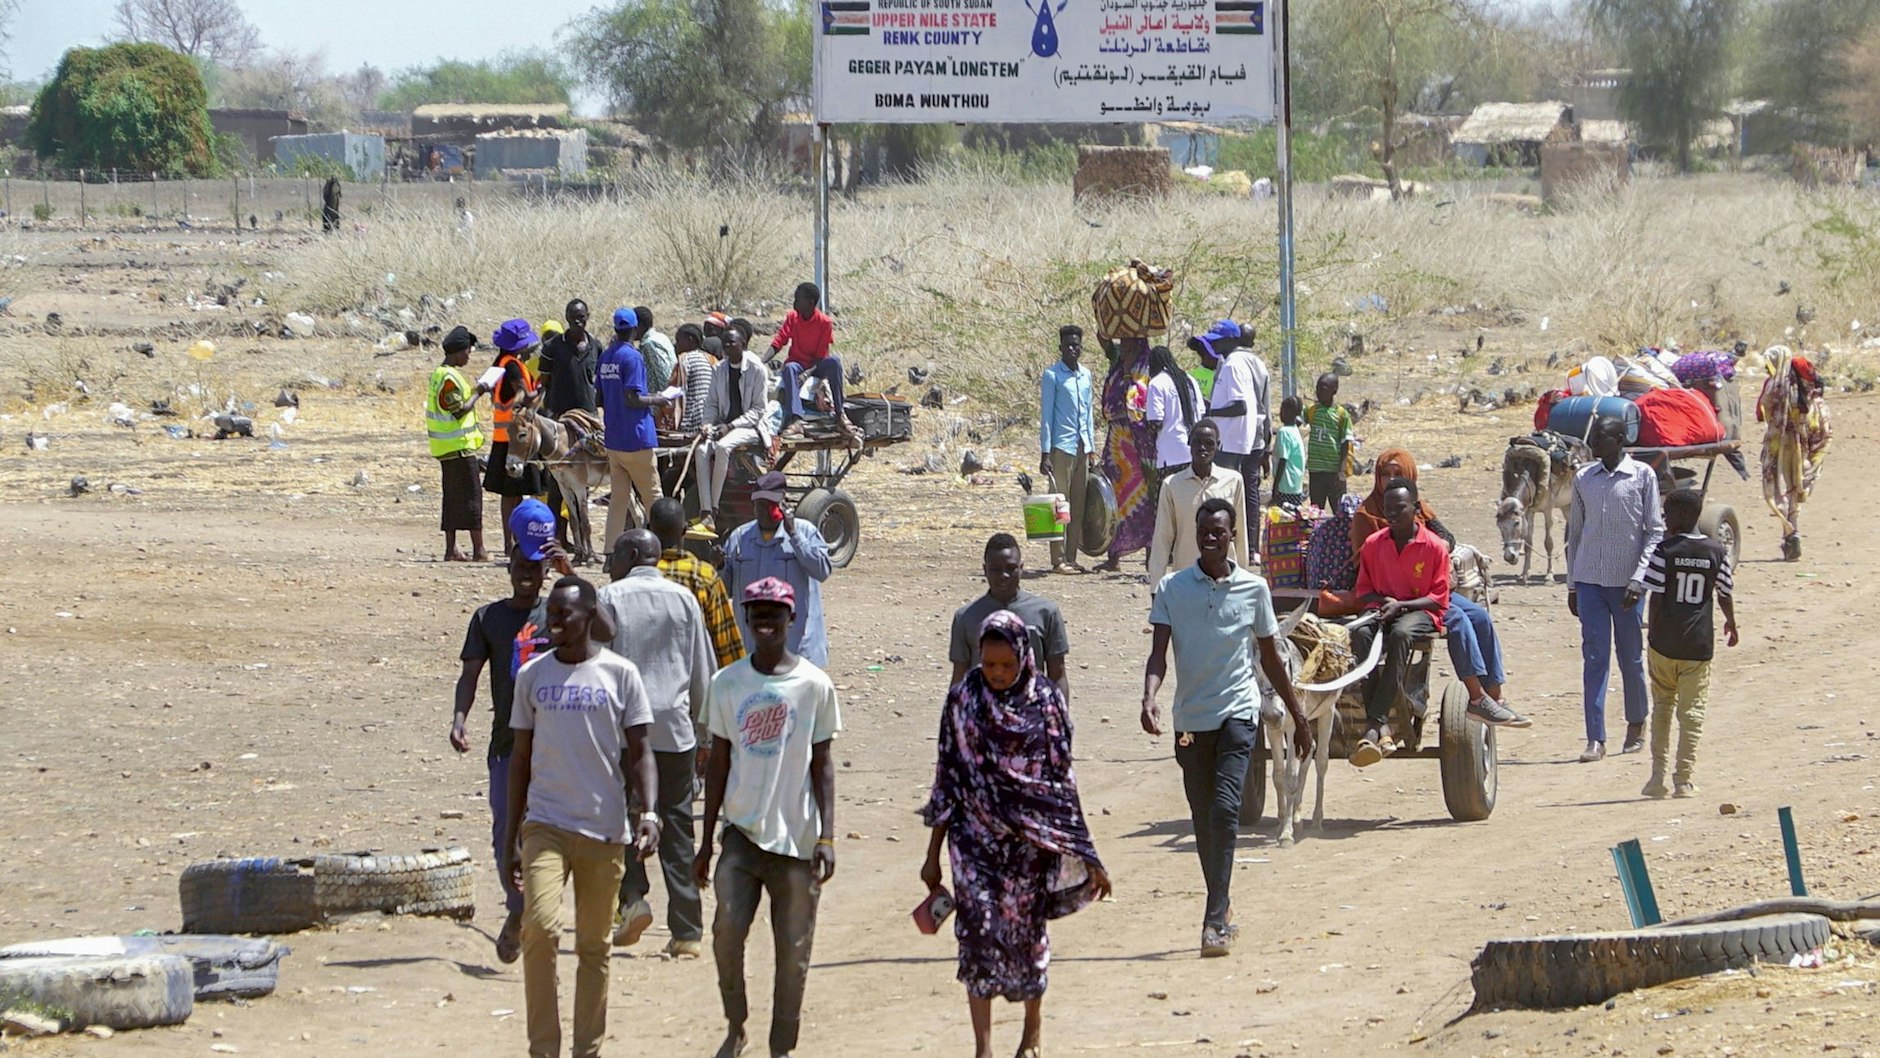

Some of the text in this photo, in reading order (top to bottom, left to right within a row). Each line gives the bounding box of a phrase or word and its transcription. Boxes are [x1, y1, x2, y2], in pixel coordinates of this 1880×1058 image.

[878, 0, 993, 9] REPUBLIC OF SOUTH SUDAN
[872, 13, 997, 27] UPPER NILE STATE
[1099, 14, 1132, 35] النيل
[1171, 14, 1210, 34] ولاية
[883, 30, 983, 45] RENK COUNTY
[1154, 37, 1210, 53] مقاطعة
[848, 60, 891, 75] GEGER
[895, 60, 947, 75] PAYAM
[1137, 63, 1206, 86] القيقر
[1211, 63, 1246, 86] فيام
[875, 93, 990, 109] BOMA WUNTHOU
[1166, 95, 1210, 117] بومة
[1674, 557, 1711, 570] RASHFORD
[1676, 571, 1706, 605] 10
[536, 685, 608, 704] GUESS
[739, 703, 788, 732] SANTA
[745, 719, 786, 747] CRUZ
